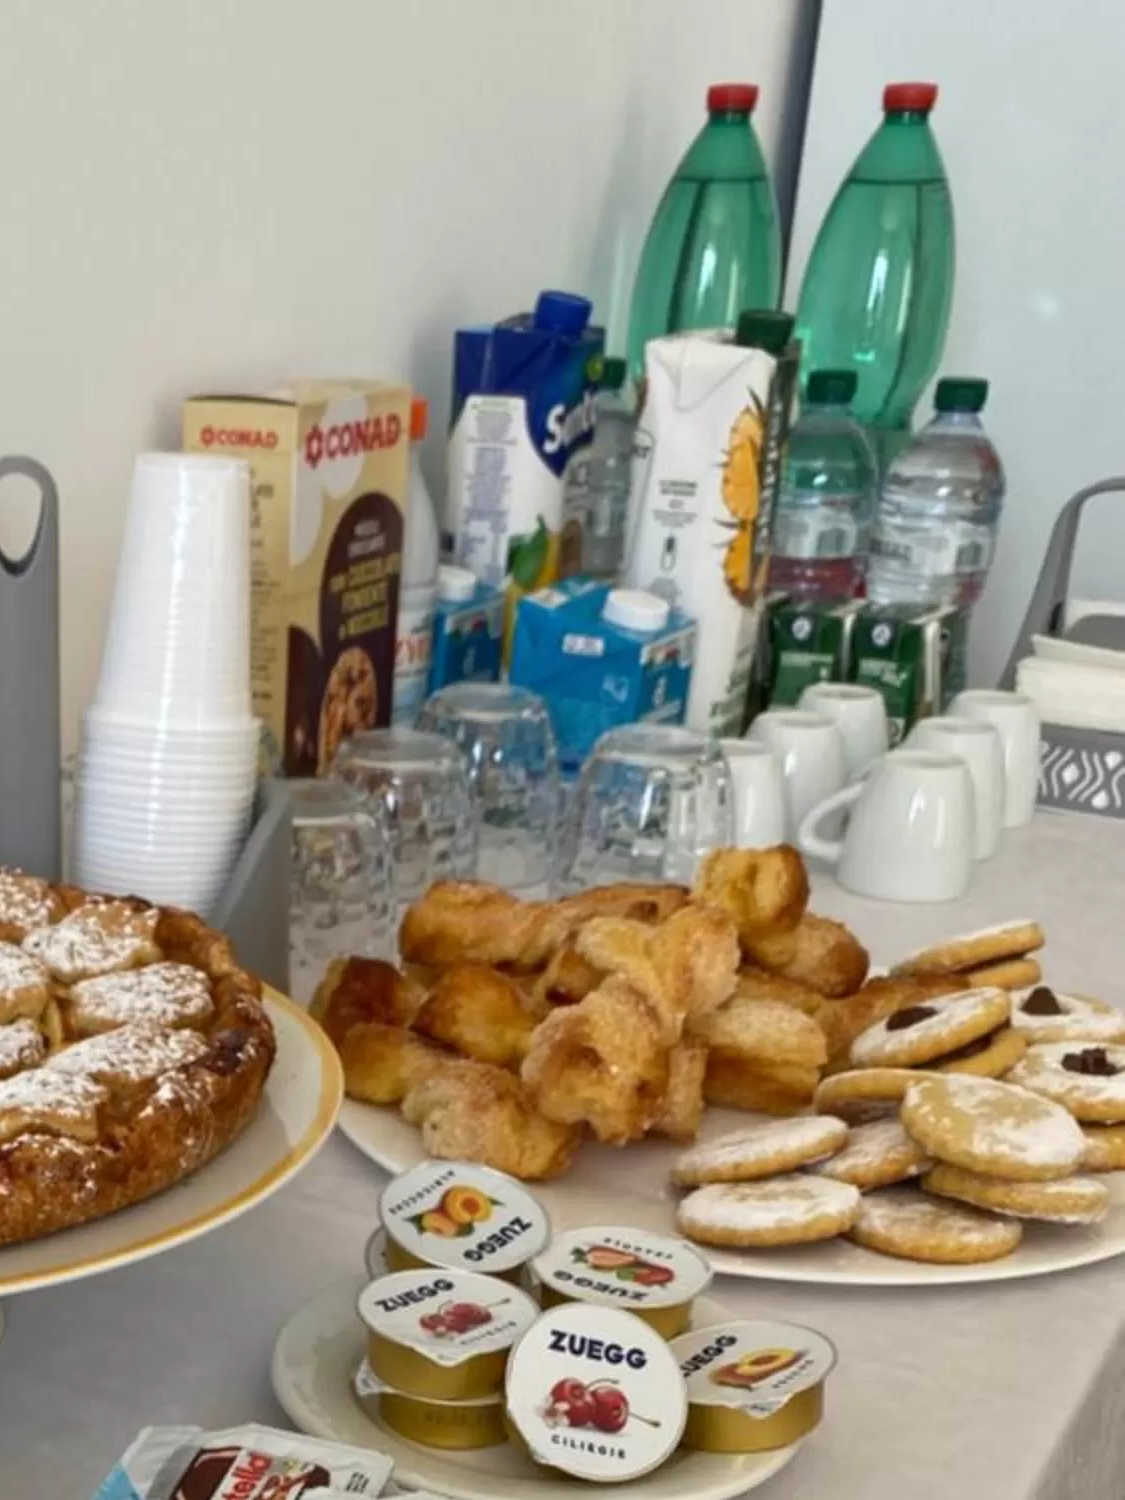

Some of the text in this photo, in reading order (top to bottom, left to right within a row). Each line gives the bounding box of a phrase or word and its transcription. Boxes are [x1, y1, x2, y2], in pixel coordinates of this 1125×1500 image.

[217, 428, 279, 449] CONAD
[326, 413, 411, 460] CONAD
[462, 1215, 533, 1263] ZUEGG
[374, 1277, 455, 1313] ZUEGG
[552, 1269, 649, 1301] ZUEGG
[547, 1328, 648, 1370] ZUEGG
[679, 1334, 739, 1378] UEGG
[551, 1433, 627, 1460] CILIEGIE
